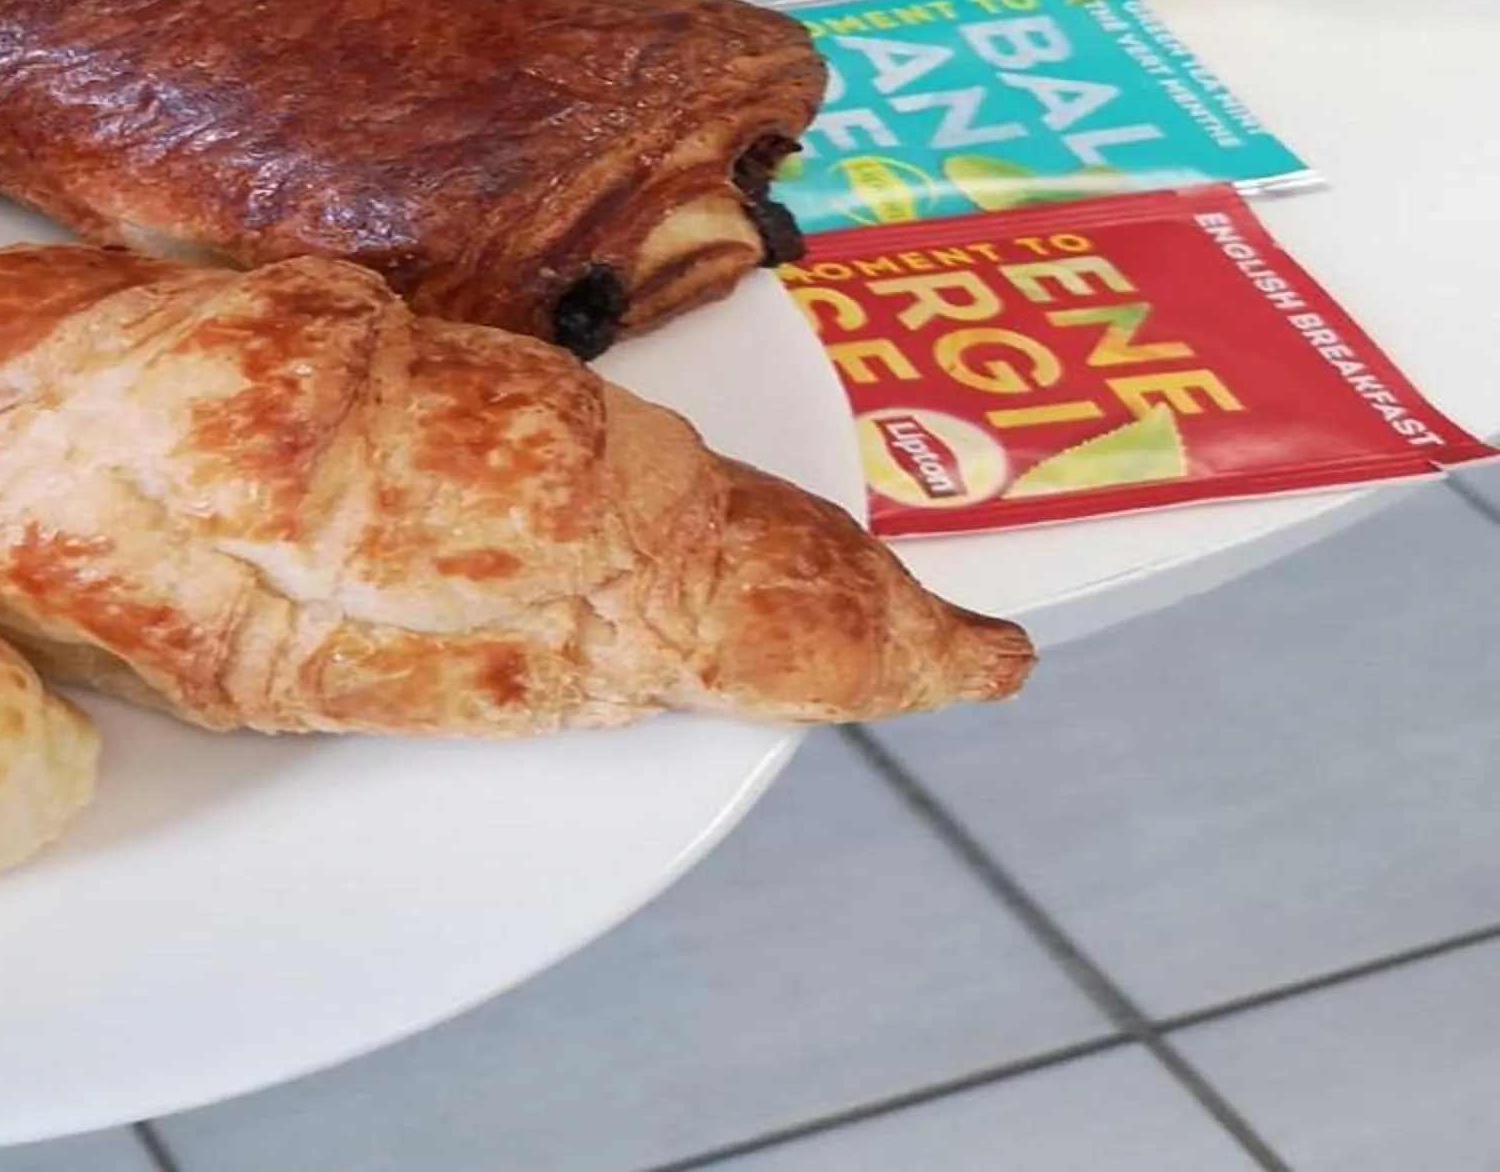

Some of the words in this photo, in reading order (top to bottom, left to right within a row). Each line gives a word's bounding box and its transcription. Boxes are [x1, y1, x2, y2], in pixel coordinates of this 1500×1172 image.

[831, 34, 1031, 149] AN
[957, 14, 1167, 166] BAL
[1012, 233, 1093, 256] TO
[787, 286, 925, 384] CE
[864, 269, 1106, 428] RGI
[998, 255, 1250, 418] ENE
[1192, 211, 1307, 310] ENGLISH
[1286, 311, 1447, 448] BREAKFAST
[886, 419, 962, 494] Lipton
